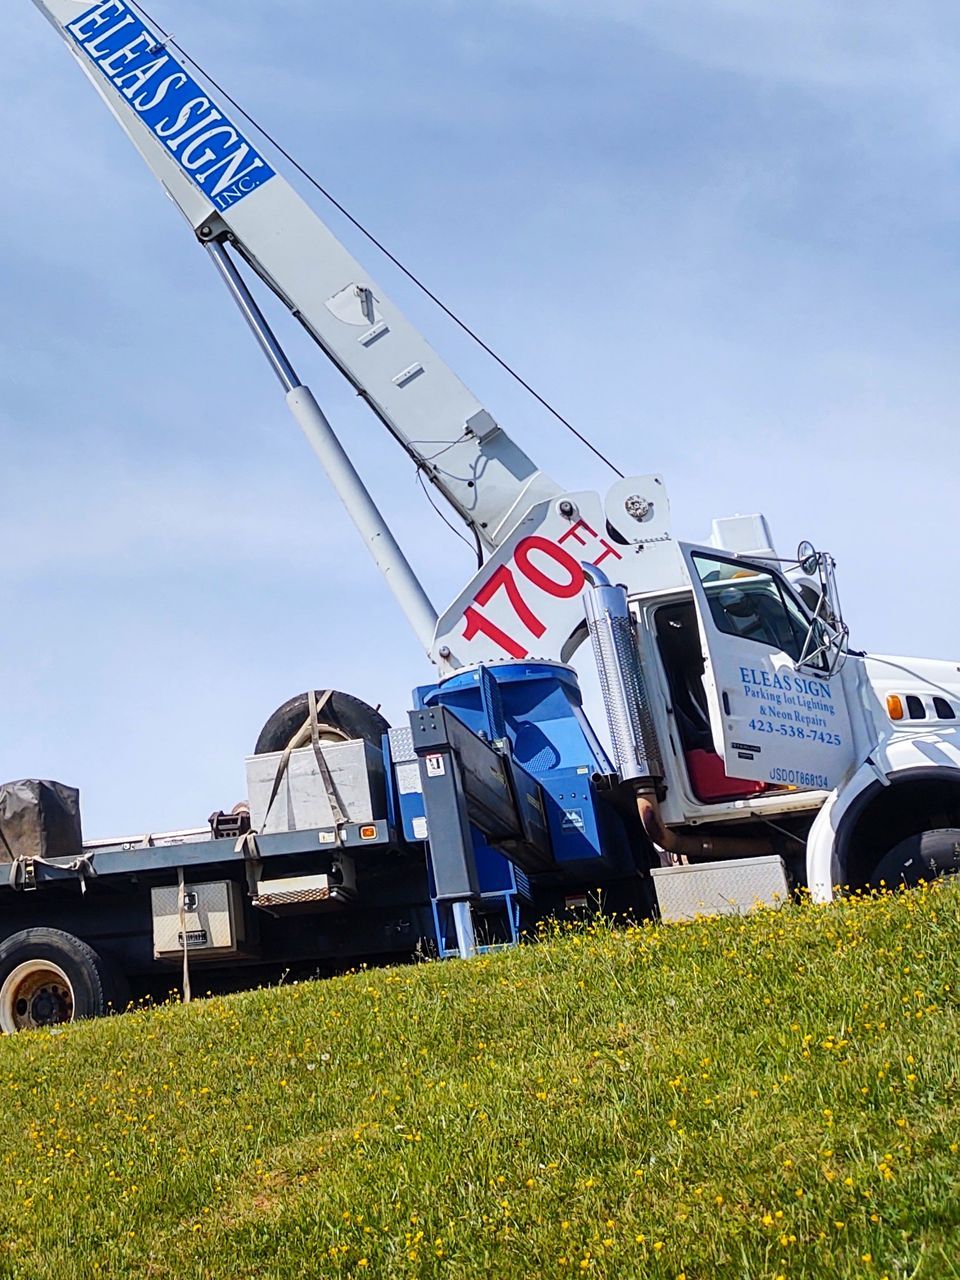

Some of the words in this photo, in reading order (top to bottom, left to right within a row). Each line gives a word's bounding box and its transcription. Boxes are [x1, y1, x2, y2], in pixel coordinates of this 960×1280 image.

[154, 97, 264, 196] SIGN
[462, 536, 585, 659] 170
[557, 518, 622, 566] FT
[739, 667, 791, 691] ELEAS
[794, 677, 832, 699] SIGN
[744, 686, 781, 705] Parking
[797, 695, 836, 716] Lighting
[759, 705, 766, 715] &
[768, 705, 793, 721] Neon
[794, 710, 827, 728] Repairs
[748, 719, 841, 746] 423-538-7425
